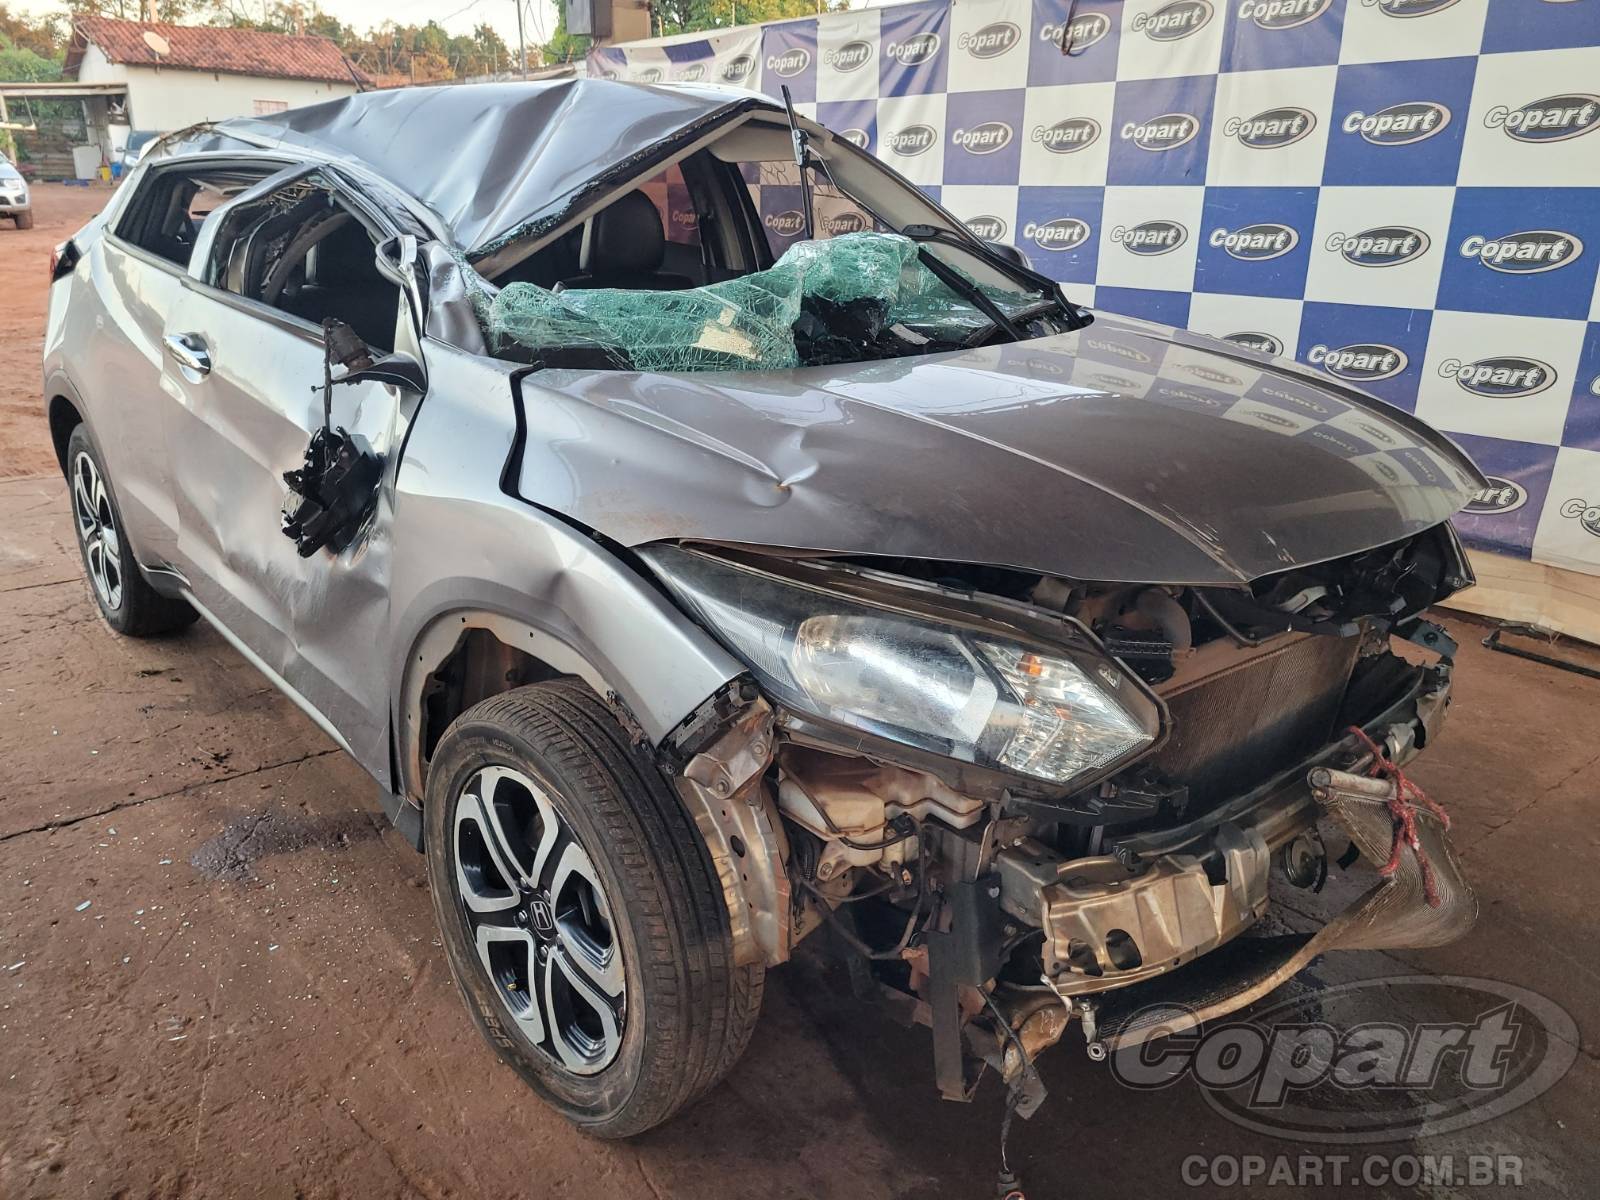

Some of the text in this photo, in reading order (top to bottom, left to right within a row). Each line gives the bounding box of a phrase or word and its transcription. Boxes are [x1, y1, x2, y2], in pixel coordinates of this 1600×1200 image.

[1133, 6, 1202, 32] Copart
[886, 38, 935, 58] Copart
[958, 29, 1011, 51] Copart
[767, 55, 804, 71] Copart
[824, 48, 865, 67] Copart
[1224, 114, 1304, 139] Copart
[1343, 107, 1437, 135] Copart
[1485, 100, 1595, 132] Copart
[886, 129, 929, 150] Copart
[953, 126, 1005, 147] Copart
[1032, 122, 1091, 144] Copart
[1120, 119, 1189, 142] Copart
[672, 210, 697, 225] Copa
[968, 222, 998, 238] art
[1023, 223, 1083, 243] Copart
[1111, 225, 1180, 248] Copart
[1209, 228, 1288, 253] Copart
[1326, 232, 1417, 258] Copart
[1460, 236, 1570, 263] Copart
[1308, 345, 1397, 373] Copart
[1438, 359, 1541, 387] Copart
[1472, 487, 1513, 505] art
